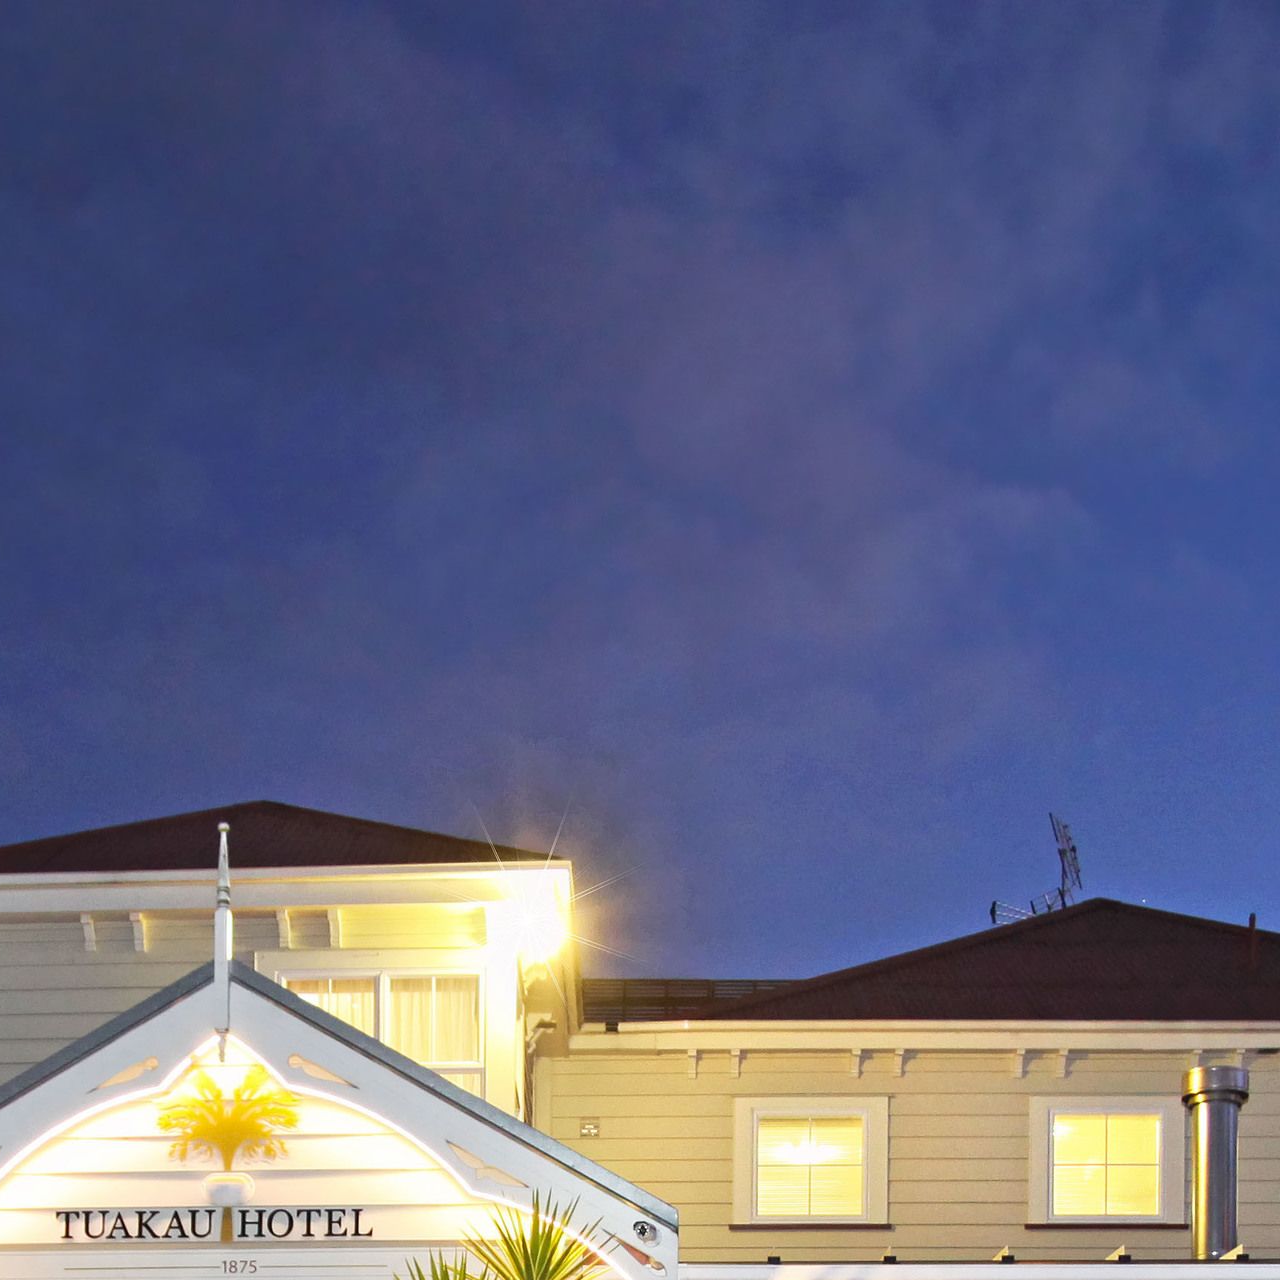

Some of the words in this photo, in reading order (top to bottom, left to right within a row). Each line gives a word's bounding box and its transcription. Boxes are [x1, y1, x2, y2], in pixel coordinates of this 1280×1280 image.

[56, 1209, 216, 1239] TUAKAU
[237, 1208, 374, 1238] HOTEL
[221, 1260, 258, 1274] 1875
